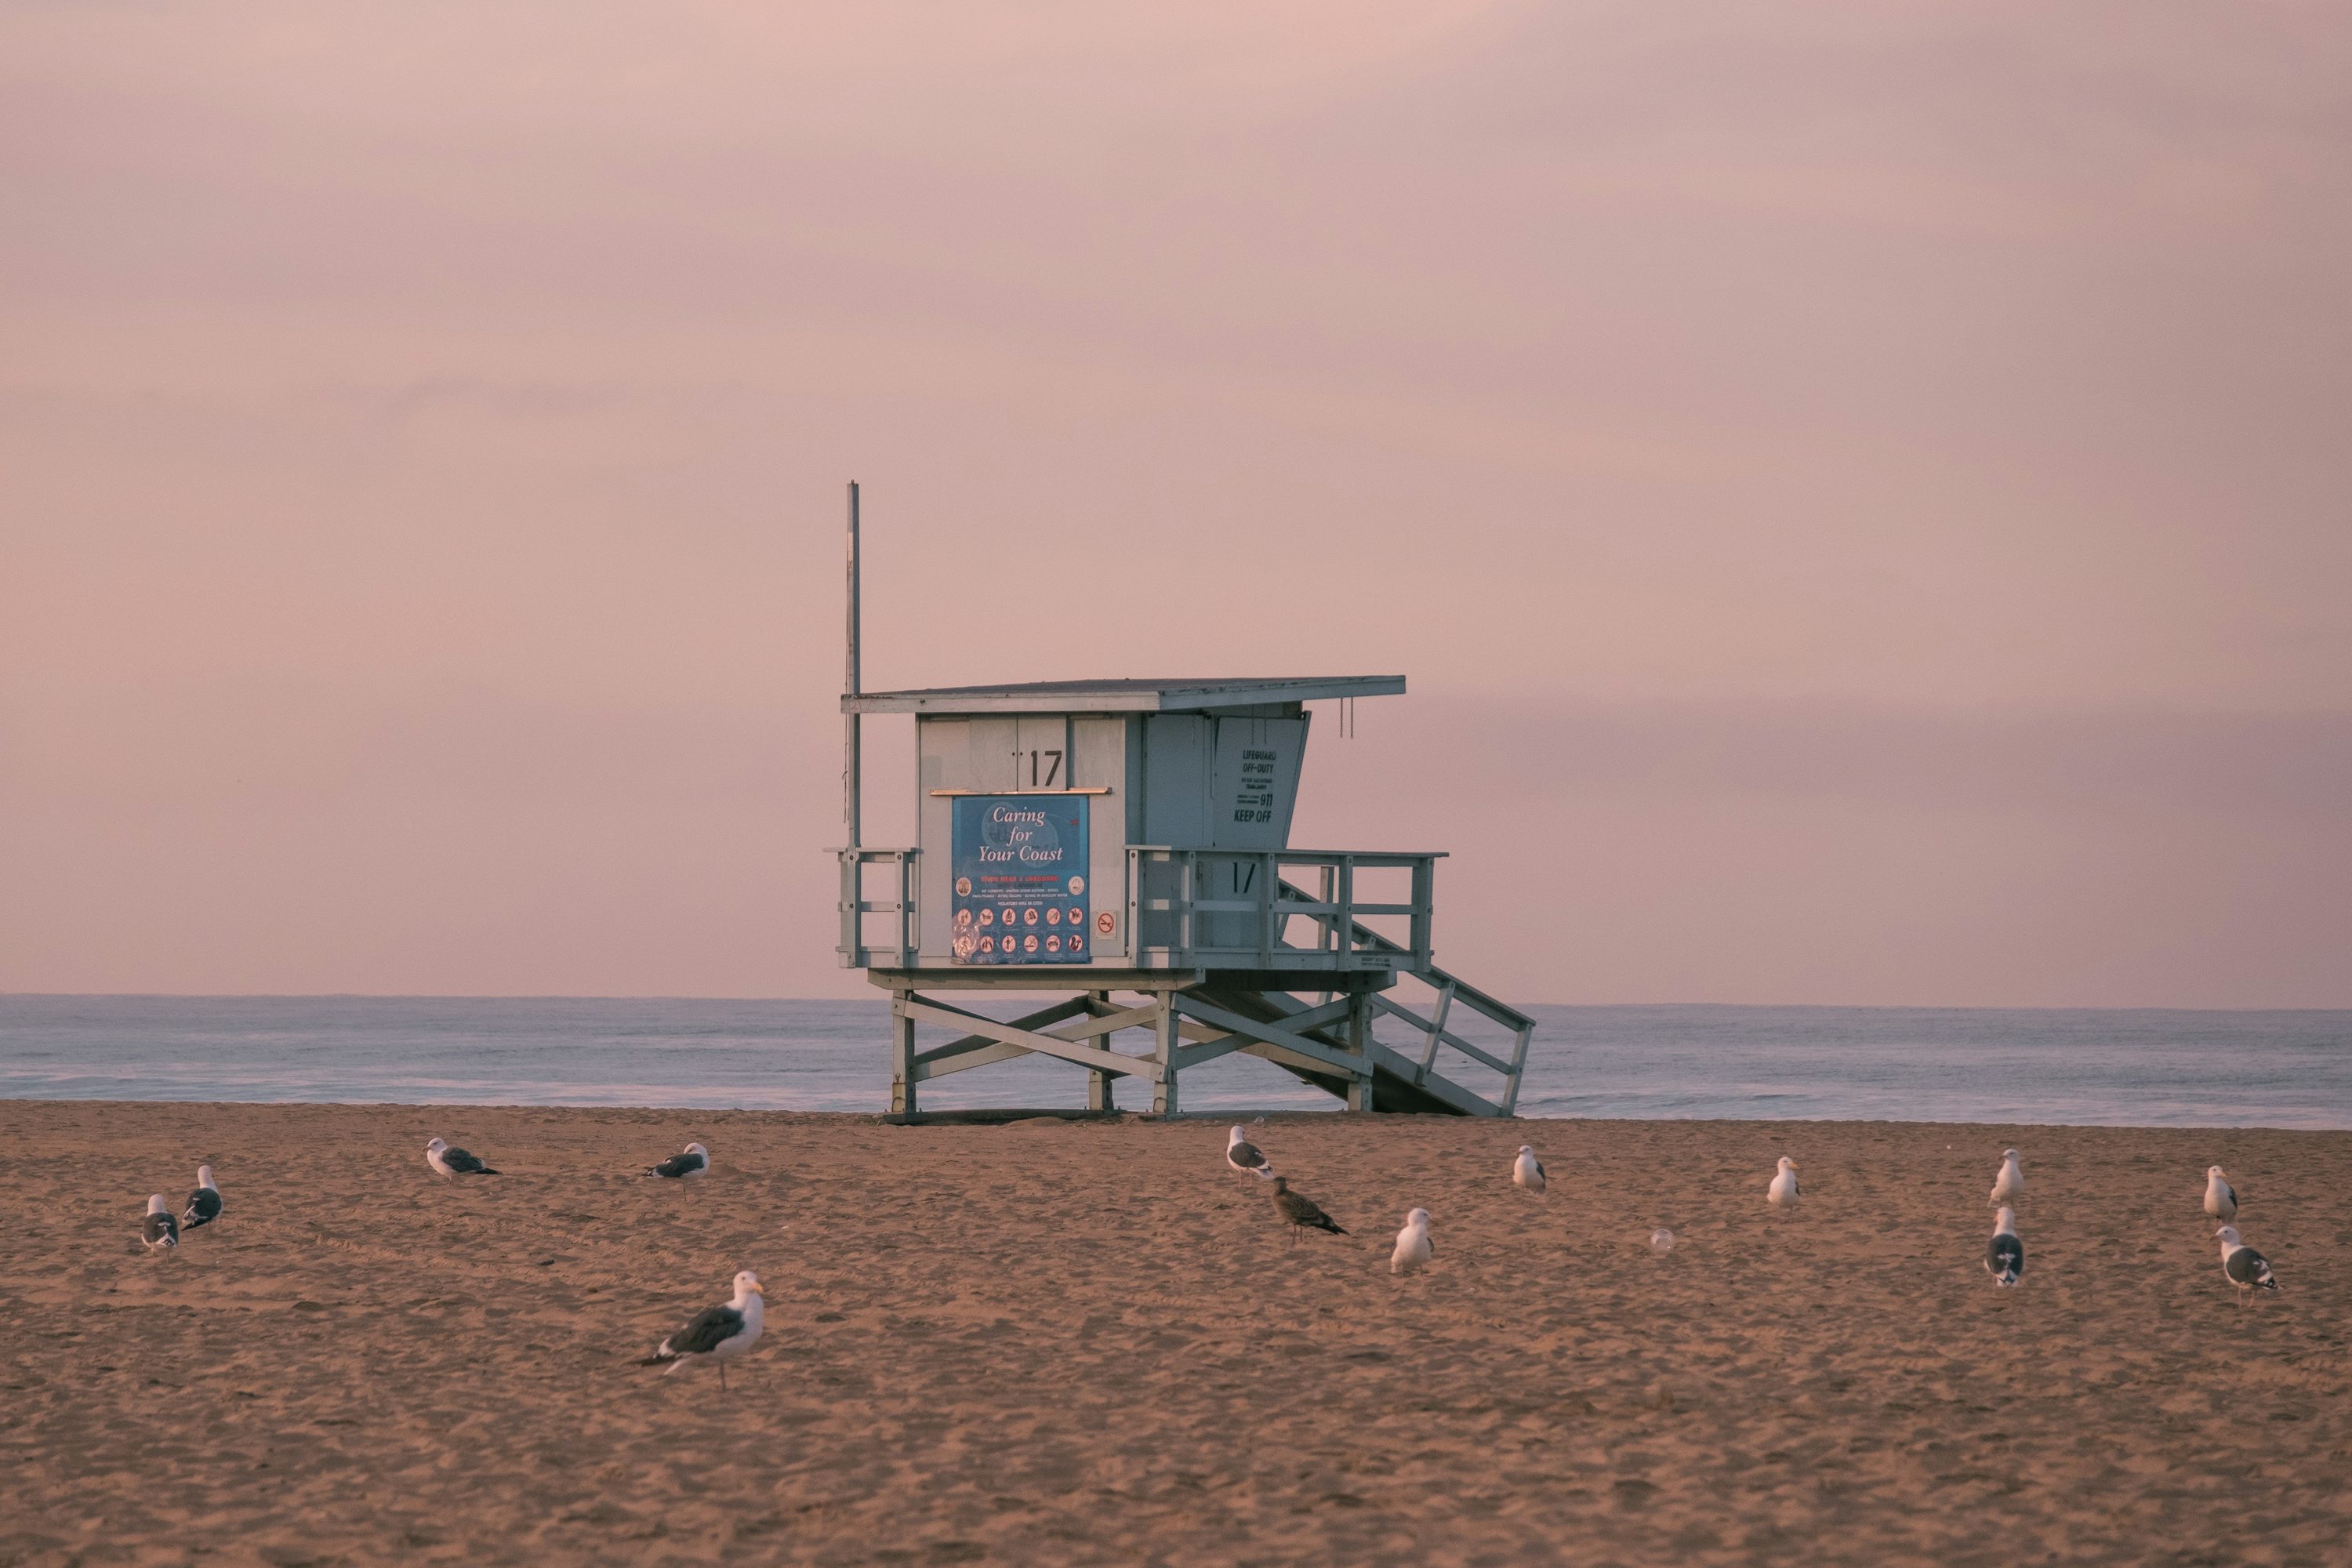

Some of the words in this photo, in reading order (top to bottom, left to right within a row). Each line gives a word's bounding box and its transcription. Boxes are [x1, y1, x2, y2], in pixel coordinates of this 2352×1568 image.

[1243, 750, 1277, 760] LIFEGUARD
[1031, 750, 1062, 786] 17
[1243, 763, 1274, 773] OFF-DUTY
[1260, 793, 1273, 807] 911
[993, 806, 1046, 827] Caring
[1234, 809, 1254, 822] KEEP
[1256, 810, 1272, 823] OFF
[1006, 826, 1033, 847] for
[979, 846, 1015, 862] Your
[1019, 845, 1064, 861] Coast
